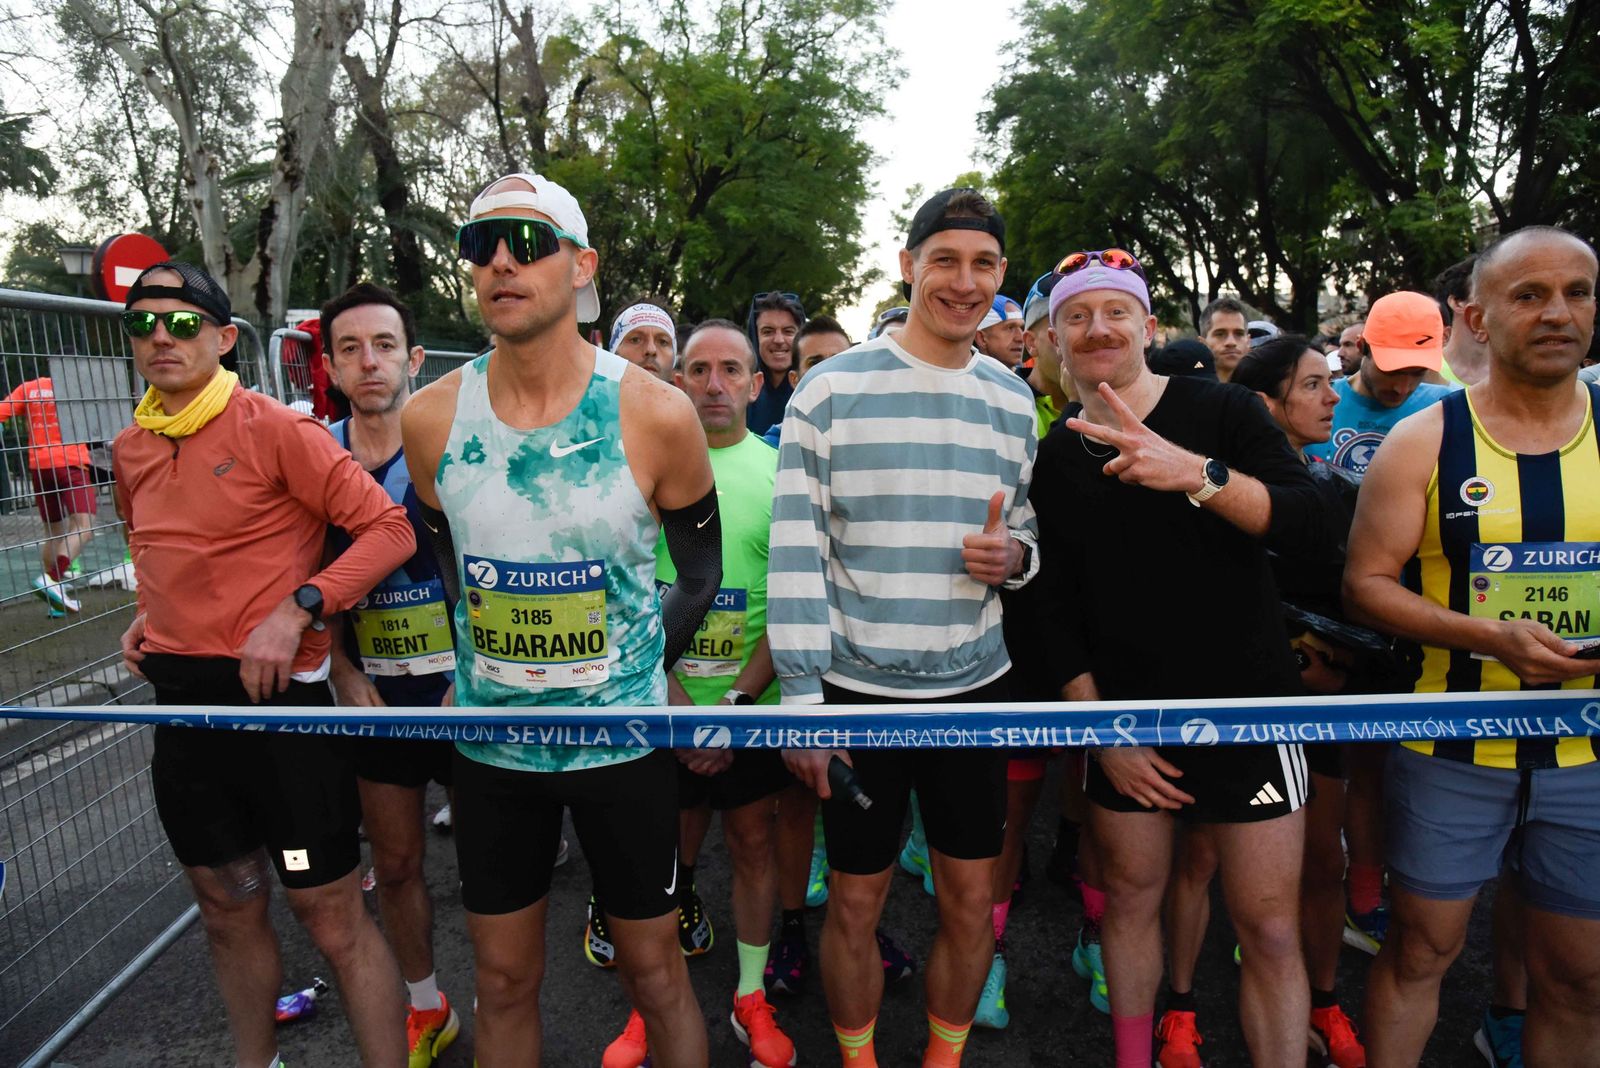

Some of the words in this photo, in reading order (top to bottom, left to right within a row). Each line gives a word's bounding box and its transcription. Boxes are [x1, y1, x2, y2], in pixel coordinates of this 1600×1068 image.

[1522, 550, 1600, 566] ZURICH
[506, 569, 587, 588] ZURICH
[374, 587, 430, 605] ZURICH
[1525, 586, 1569, 602] 2146
[381, 618, 409, 632] 1814
[511, 608, 553, 625] 3185
[371, 633, 429, 655] BRENT
[472, 625, 605, 658] BEJARANO
[685, 638, 734, 657] AELO
[506, 725, 613, 746] SEVILLA
[744, 728, 850, 748] ZURICH
[867, 725, 977, 748] MARATÓN
[990, 726, 1101, 747] SEVILLA
[1231, 722, 1337, 743] ZURICH
[1348, 716, 1458, 740] MARATÓN
[1465, 716, 1575, 738] SEVILLA
